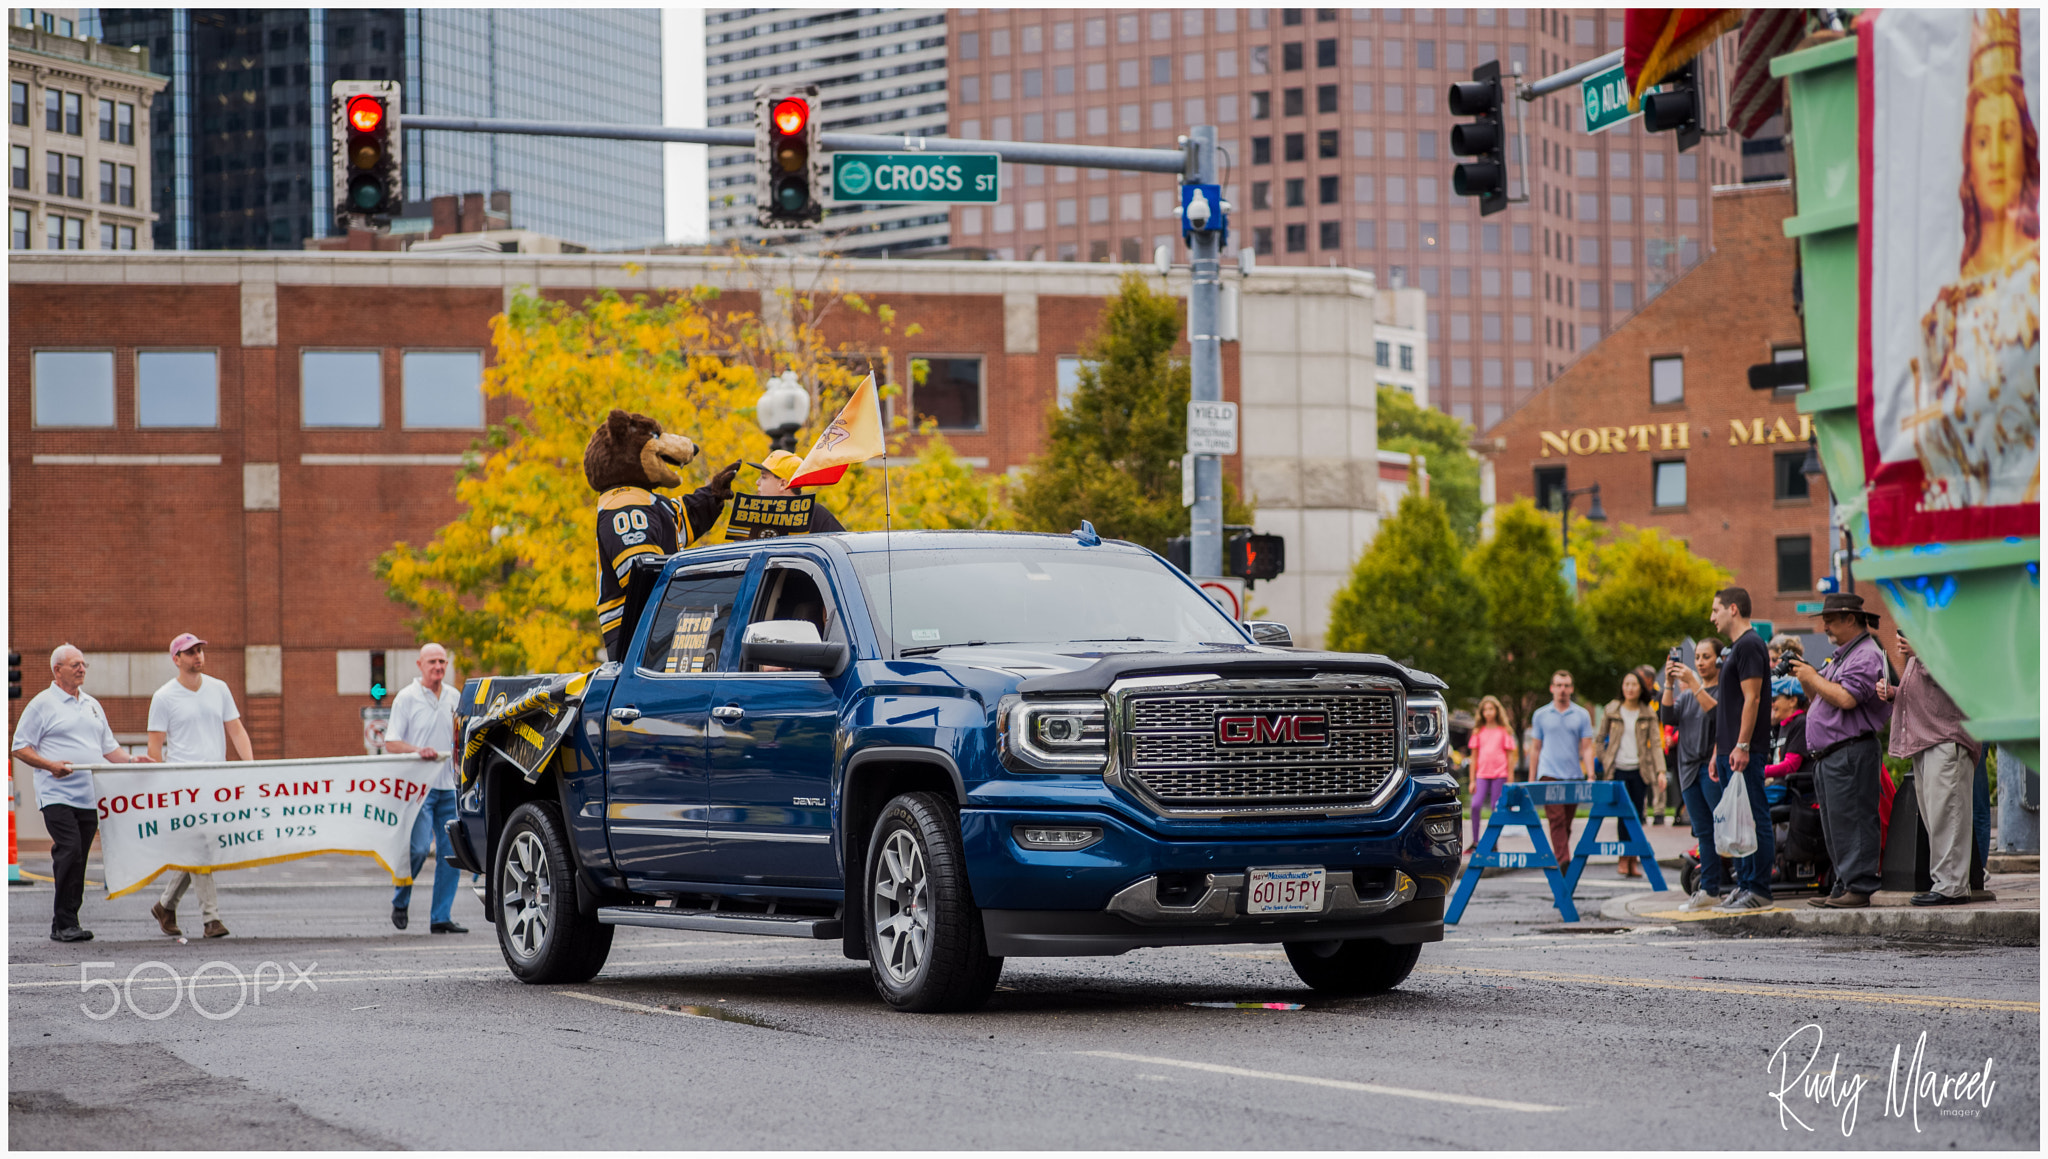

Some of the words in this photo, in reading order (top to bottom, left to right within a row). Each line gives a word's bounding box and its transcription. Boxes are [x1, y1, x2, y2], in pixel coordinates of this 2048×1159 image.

[874, 164, 963, 191] CROSS
[975, 174, 996, 191] ST
[1194, 406, 1232, 419] YIELD
[1540, 422, 1690, 457] NORTH
[738, 497, 788, 513] LET'S
[789, 498, 812, 512] GO
[613, 509, 649, 535] 00
[735, 510, 810, 527] BRUINS!
[1219, 715, 1325, 744] GMC
[97, 788, 200, 820] SOCIETY
[214, 785, 245, 802] OF
[258, 779, 335, 798] SAINT
[793, 797, 826, 806] DENALI
[138, 820, 158, 839] IN
[170, 807, 271, 831] BOSTON'S
[282, 802, 352, 817] NORTH
[363, 803, 398, 827] END
[218, 829, 264, 848] SINCE
[275, 825, 317, 839] 1925
[1499, 853, 1527, 868] BPD
[1602, 843, 1625, 856] BPD
[1253, 880, 1321, 903] 6015PY
